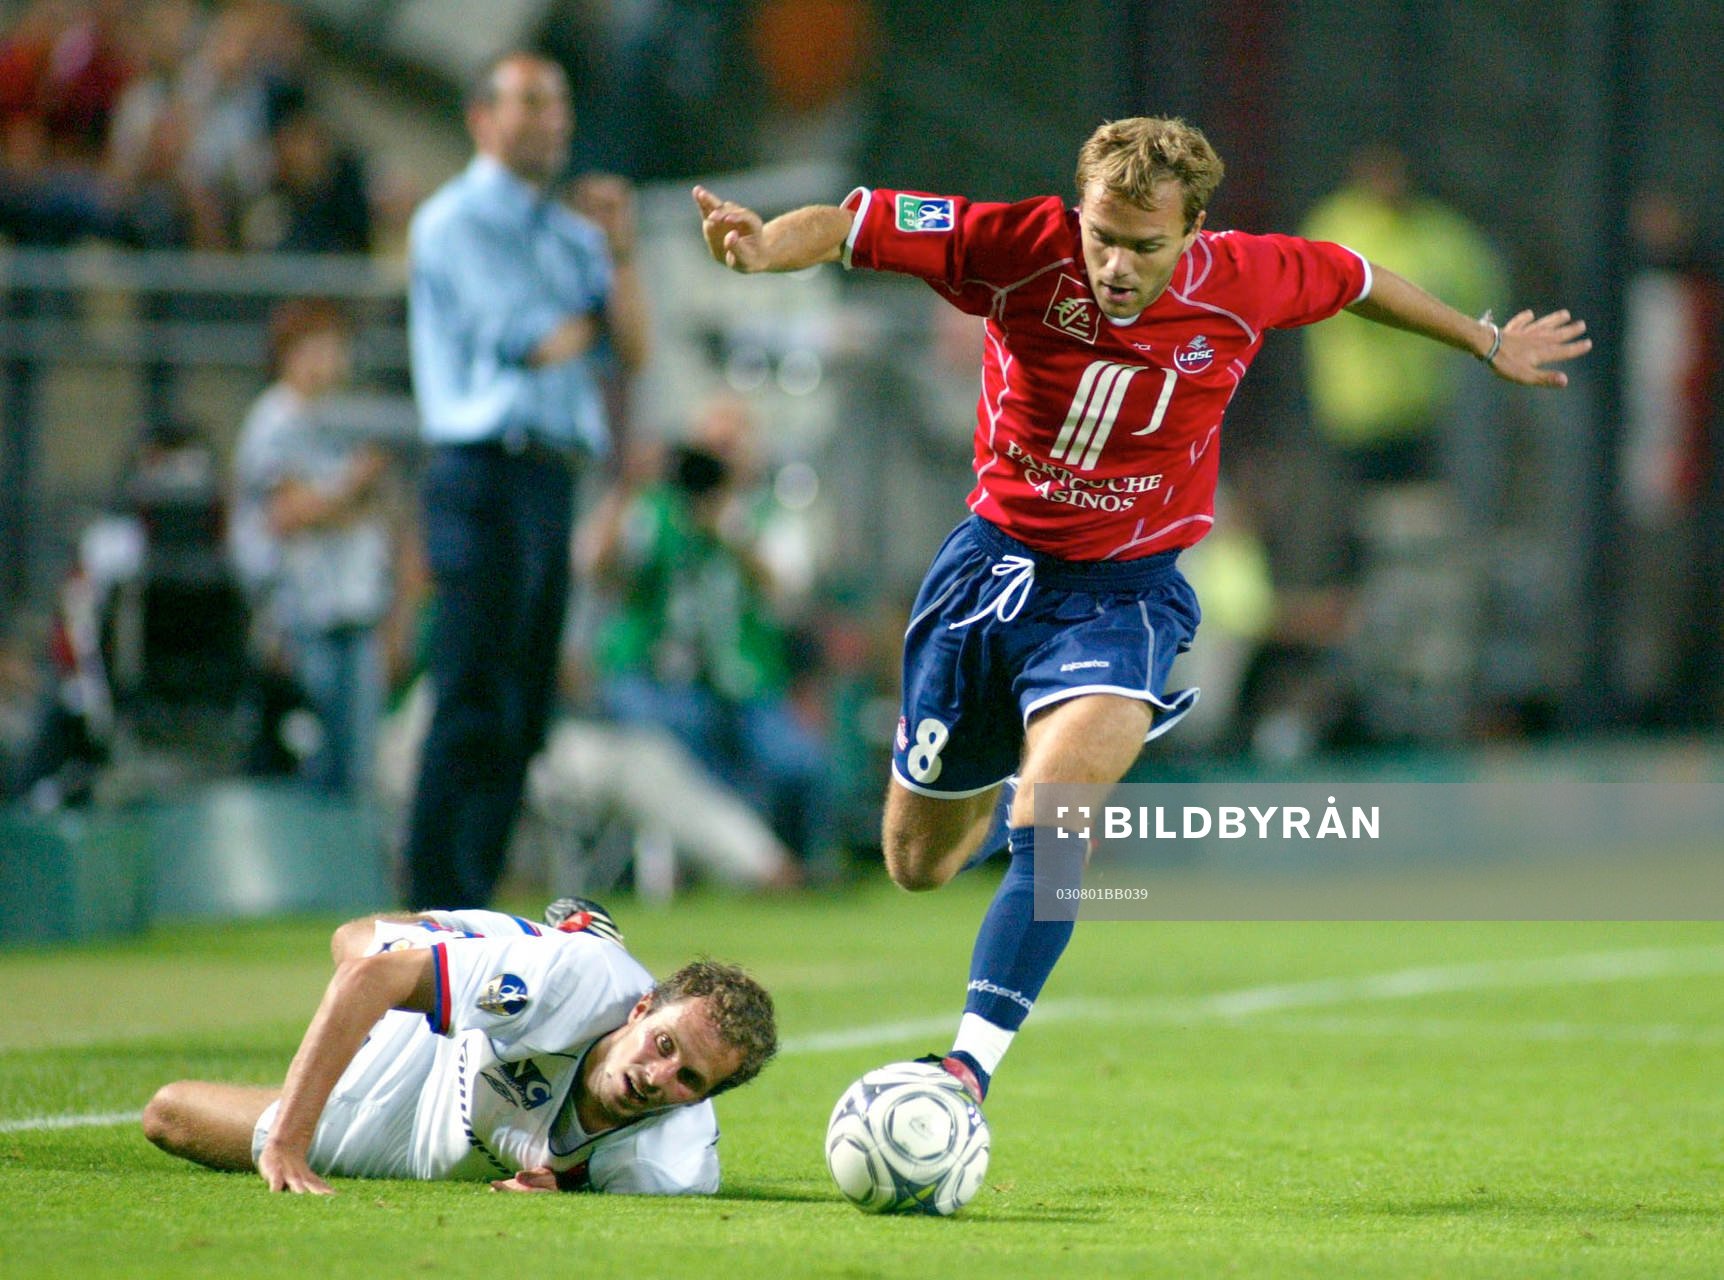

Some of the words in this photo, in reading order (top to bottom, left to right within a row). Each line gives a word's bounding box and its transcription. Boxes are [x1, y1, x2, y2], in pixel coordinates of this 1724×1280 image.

[1179, 348, 1215, 362] LOSC
[1023, 468, 1136, 512] CASINOS
[907, 717, 950, 784] 8
